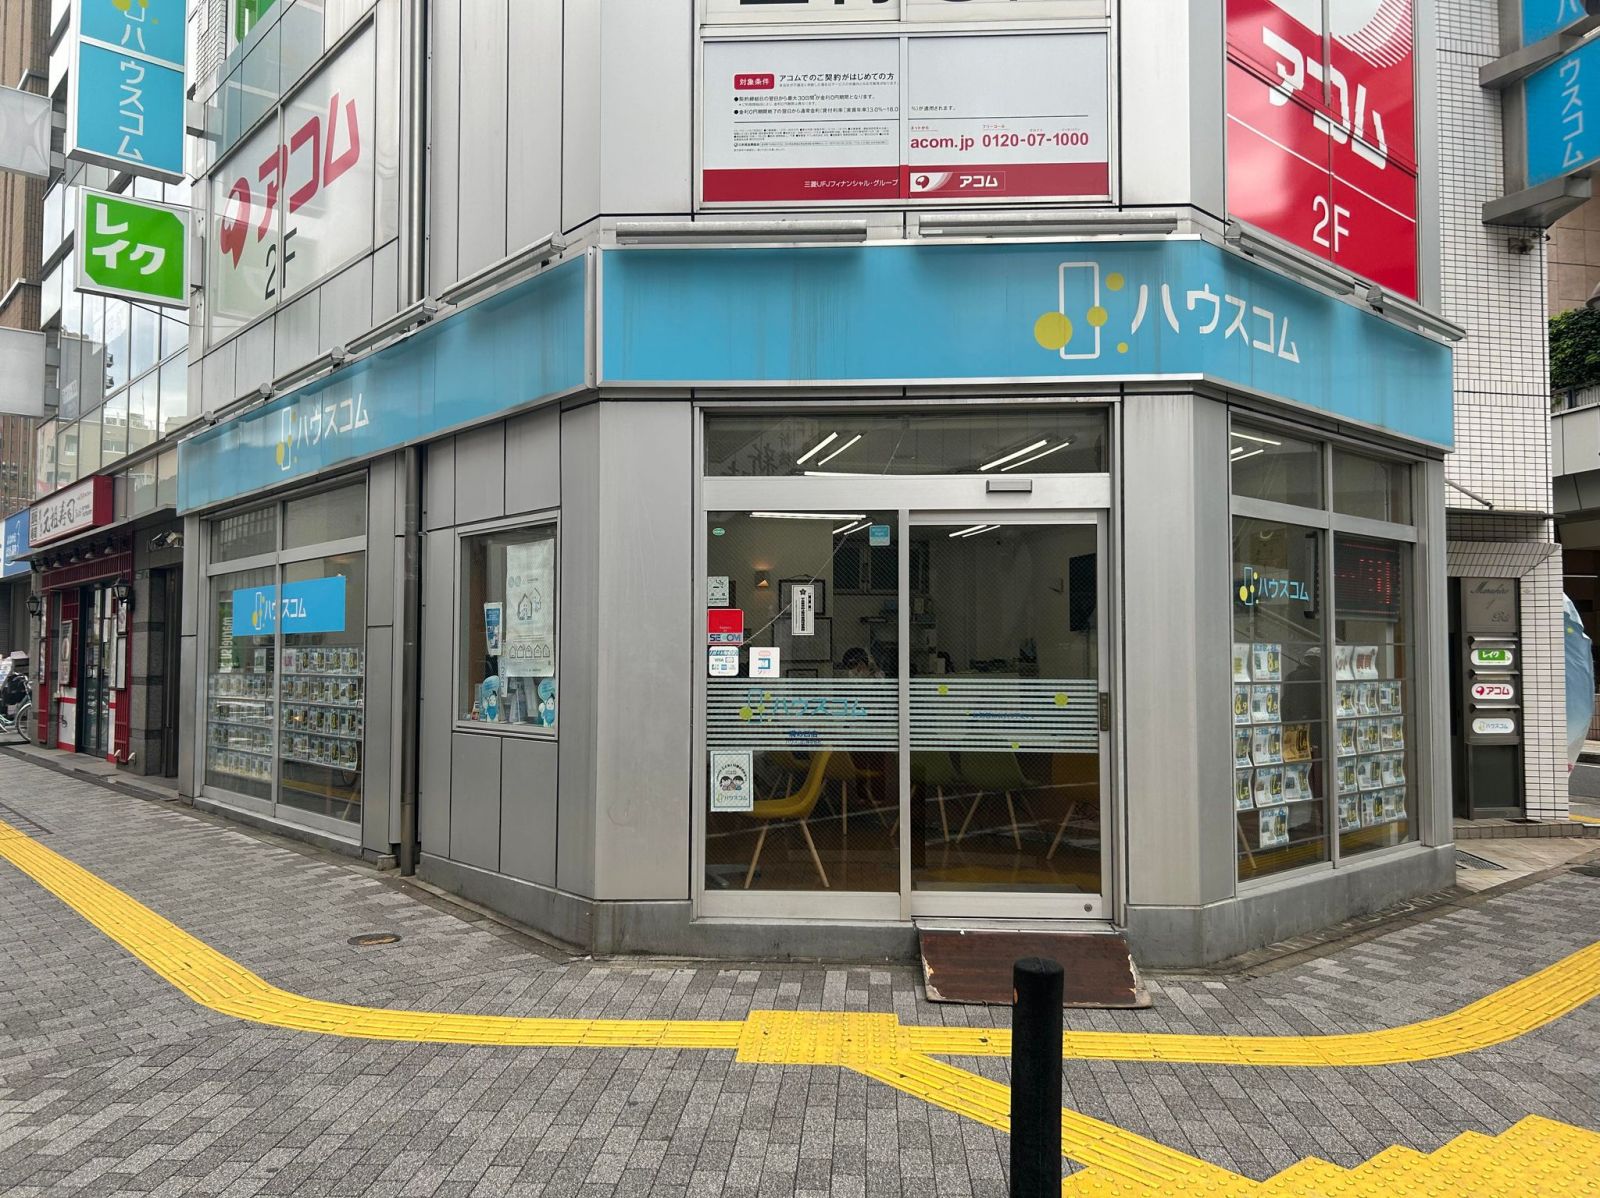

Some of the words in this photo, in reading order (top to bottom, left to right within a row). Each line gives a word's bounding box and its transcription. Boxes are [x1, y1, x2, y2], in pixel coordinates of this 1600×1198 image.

[738, 77, 770, 86] 対象条件
[779, 72, 895, 83] アコムでのご契約がはじめての方
[117, 24, 146, 162] ハウスコム
[1262, 26, 1388, 171] アコム
[910, 134, 975, 152] acom.jp
[982, 132, 1089, 148] 0120-07-1000
[257, 91, 361, 244] アコム
[804, 179, 899, 188] 三菱UFJフィナンシャル・グループ
[959, 175, 998, 188] アコム
[1312, 195, 1350, 252] 2F
[264, 227, 297, 300] 2F
[1131, 282, 1301, 364] ハウスコム
[296, 392, 370, 449] ハウスコム
[1258, 577, 1310, 602] ハウスコム
[1486, 686, 1510, 696] アコム
[772, 698, 867, 717] ハウスコム
